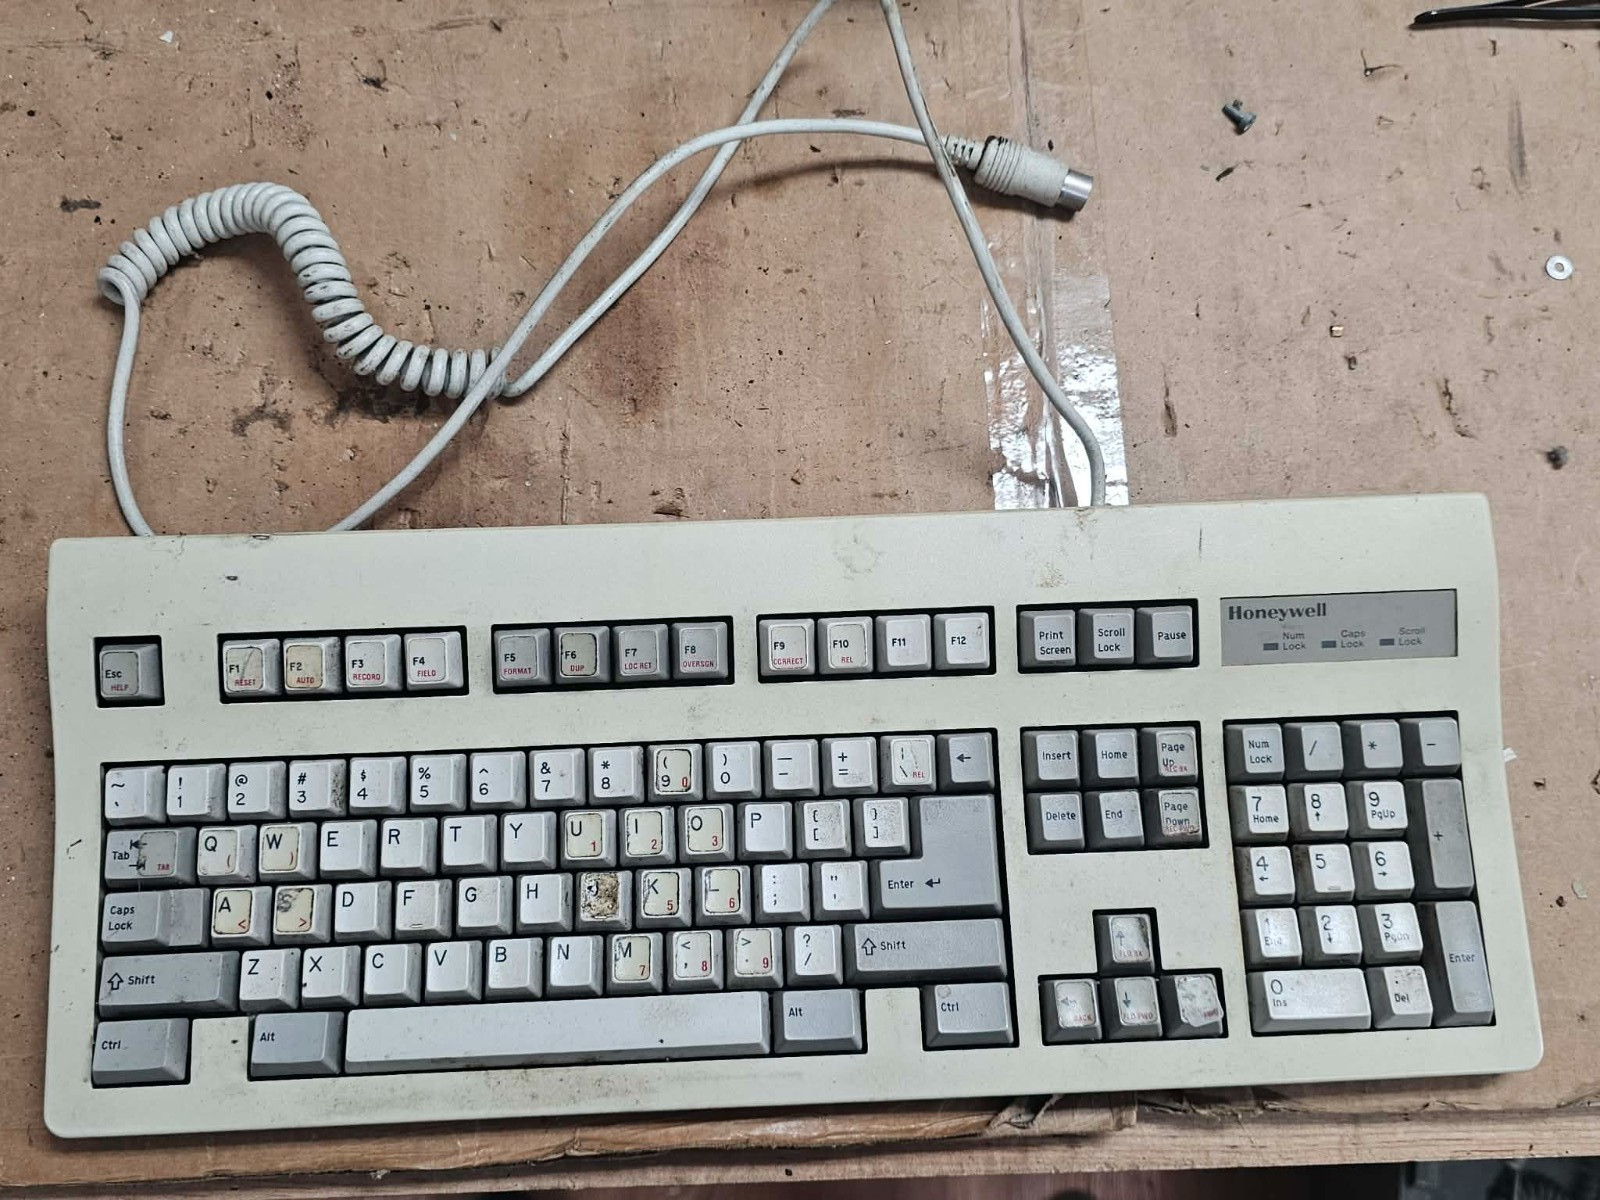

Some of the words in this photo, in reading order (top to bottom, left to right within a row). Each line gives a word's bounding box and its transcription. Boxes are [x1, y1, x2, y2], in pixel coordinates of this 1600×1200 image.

[1228, 602, 1327, 621] Honeywell
[1039, 630, 1064, 641] Print
[1098, 628, 1126, 637] Scroll
[1157, 631, 1187, 640] Pause
[1283, 631, 1305, 640] Num
[1341, 629, 1366, 639] Caps
[1398, 627, 1426, 636] Scroll
[773, 641, 785, 650] F9
[832, 640, 849, 649] F10
[892, 638, 907, 647] F11
[951, 636, 967, 645] F12
[1283, 642, 1307, 650] Lock
[1341, 640, 1364, 648] Lock
[1398, 637, 1423, 646] Lock
[624, 648, 638, 657] F7
[684, 645, 697, 655] F8
[1039, 646, 1072, 655] Screen
[1098, 643, 1121, 652] Lock
[504, 653, 517, 662] F5
[565, 651, 577, 660] F6
[841, 656, 854, 664] REL
[290, 662, 302, 671] F2
[351, 660, 365, 669] F3
[412, 657, 426, 666] F4
[682, 661, 715, 669] OVERSGN
[773, 657, 804, 666] CORRECT
[105, 669, 122, 679] Esc
[228, 664, 240, 674] F1
[416, 670, 437, 678] FIELD
[503, 667, 533, 675] FORMAT
[296, 676, 315, 685] AUTO
[352, 673, 381, 681] RECORD
[111, 684, 128, 692] HELP
[234, 679, 257, 687] RESET
[1161, 742, 1185, 752] Page
[1248, 740, 1270, 748] Num
[838, 752, 848, 762] +
[1042, 751, 1072, 761] Insert
[1101, 750, 1128, 759] Home
[1249, 755, 1272, 764] Lock
[1162, 758, 1175, 767] Up
[418, 767, 431, 780] %
[540, 762, 551, 775] &
[235, 774, 248, 787] @
[297, 772, 307, 785] #
[360, 769, 367, 782] $
[661, 774, 671, 787] 9
[178, 777, 182, 790] !
[541, 780, 551, 793] 7
[601, 777, 611, 790] 8
[682, 776, 688, 788] 0
[357, 788, 368, 800] 4
[419, 785, 429, 798] 5
[479, 783, 489, 795] 6
[177, 795, 182, 808] 1
[236, 793, 246, 806] 2
[297, 791, 307, 803] 3
[1310, 793, 1321, 809] 8
[1369, 791, 1380, 807] 9
[1164, 801, 1188, 811] Page
[1251, 796, 1262, 811] 7
[1045, 811, 1076, 821] Delete
[1105, 810, 1123, 819] End
[1253, 814, 1279, 823] Home
[1371, 810, 1396, 820] PgUp
[690, 815, 703, 831] O
[751, 813, 762, 828] P
[1165, 818, 1190, 826] Down
[450, 826, 462, 842] T
[510, 823, 523, 839] Y
[570, 821, 582, 837] U
[266, 834, 283, 849] W
[327, 831, 339, 847] E
[388, 828, 400, 845] R
[712, 836, 718, 847] 3
[204, 836, 217, 852] Q
[591, 841, 596, 852] 1
[651, 839, 657, 850] 2
[112, 851, 130, 860] Tab
[1315, 853, 1326, 869] 5
[1374, 851, 1387, 867] 6
[1256, 855, 1269, 871] 4
[648, 878, 660, 894] K
[887, 879, 915, 890] Enter
[465, 886, 477, 902] G
[526, 883, 538, 899] H
[342, 891, 354, 907] D
[403, 890, 416, 906] F
[729, 897, 735, 909] 6
[218, 897, 232, 913] A
[667, 900, 673, 911] 5
[110, 906, 136, 916] Caps
[108, 921, 133, 931] Lock
[1321, 914, 1332, 930] 2
[1381, 913, 1393, 929] 3
[803, 933, 811, 947] ?
[880, 940, 906, 951] Shift
[495, 946, 507, 962] B
[557, 944, 570, 960] N
[618, 941, 632, 958] M
[372, 952, 384, 969] C
[434, 950, 447, 966] V
[762, 957, 769, 969] 9
[1449, 953, 1476, 963] Enter
[247, 959, 260, 975] Z
[309, 956, 323, 973] X
[701, 961, 708, 971] 8
[639, 965, 646, 976] 7
[127, 975, 155, 985] Shift
[1270, 979, 1283, 995] 0
[1272, 999, 1287, 1007] Ins
[1395, 993, 1410, 1003] Del
[788, 1007, 803, 1017] Alt
[940, 1002, 959, 1012] Ctrl
[260, 1032, 275, 1041] Alt
[101, 1040, 121, 1050] Ctrl
